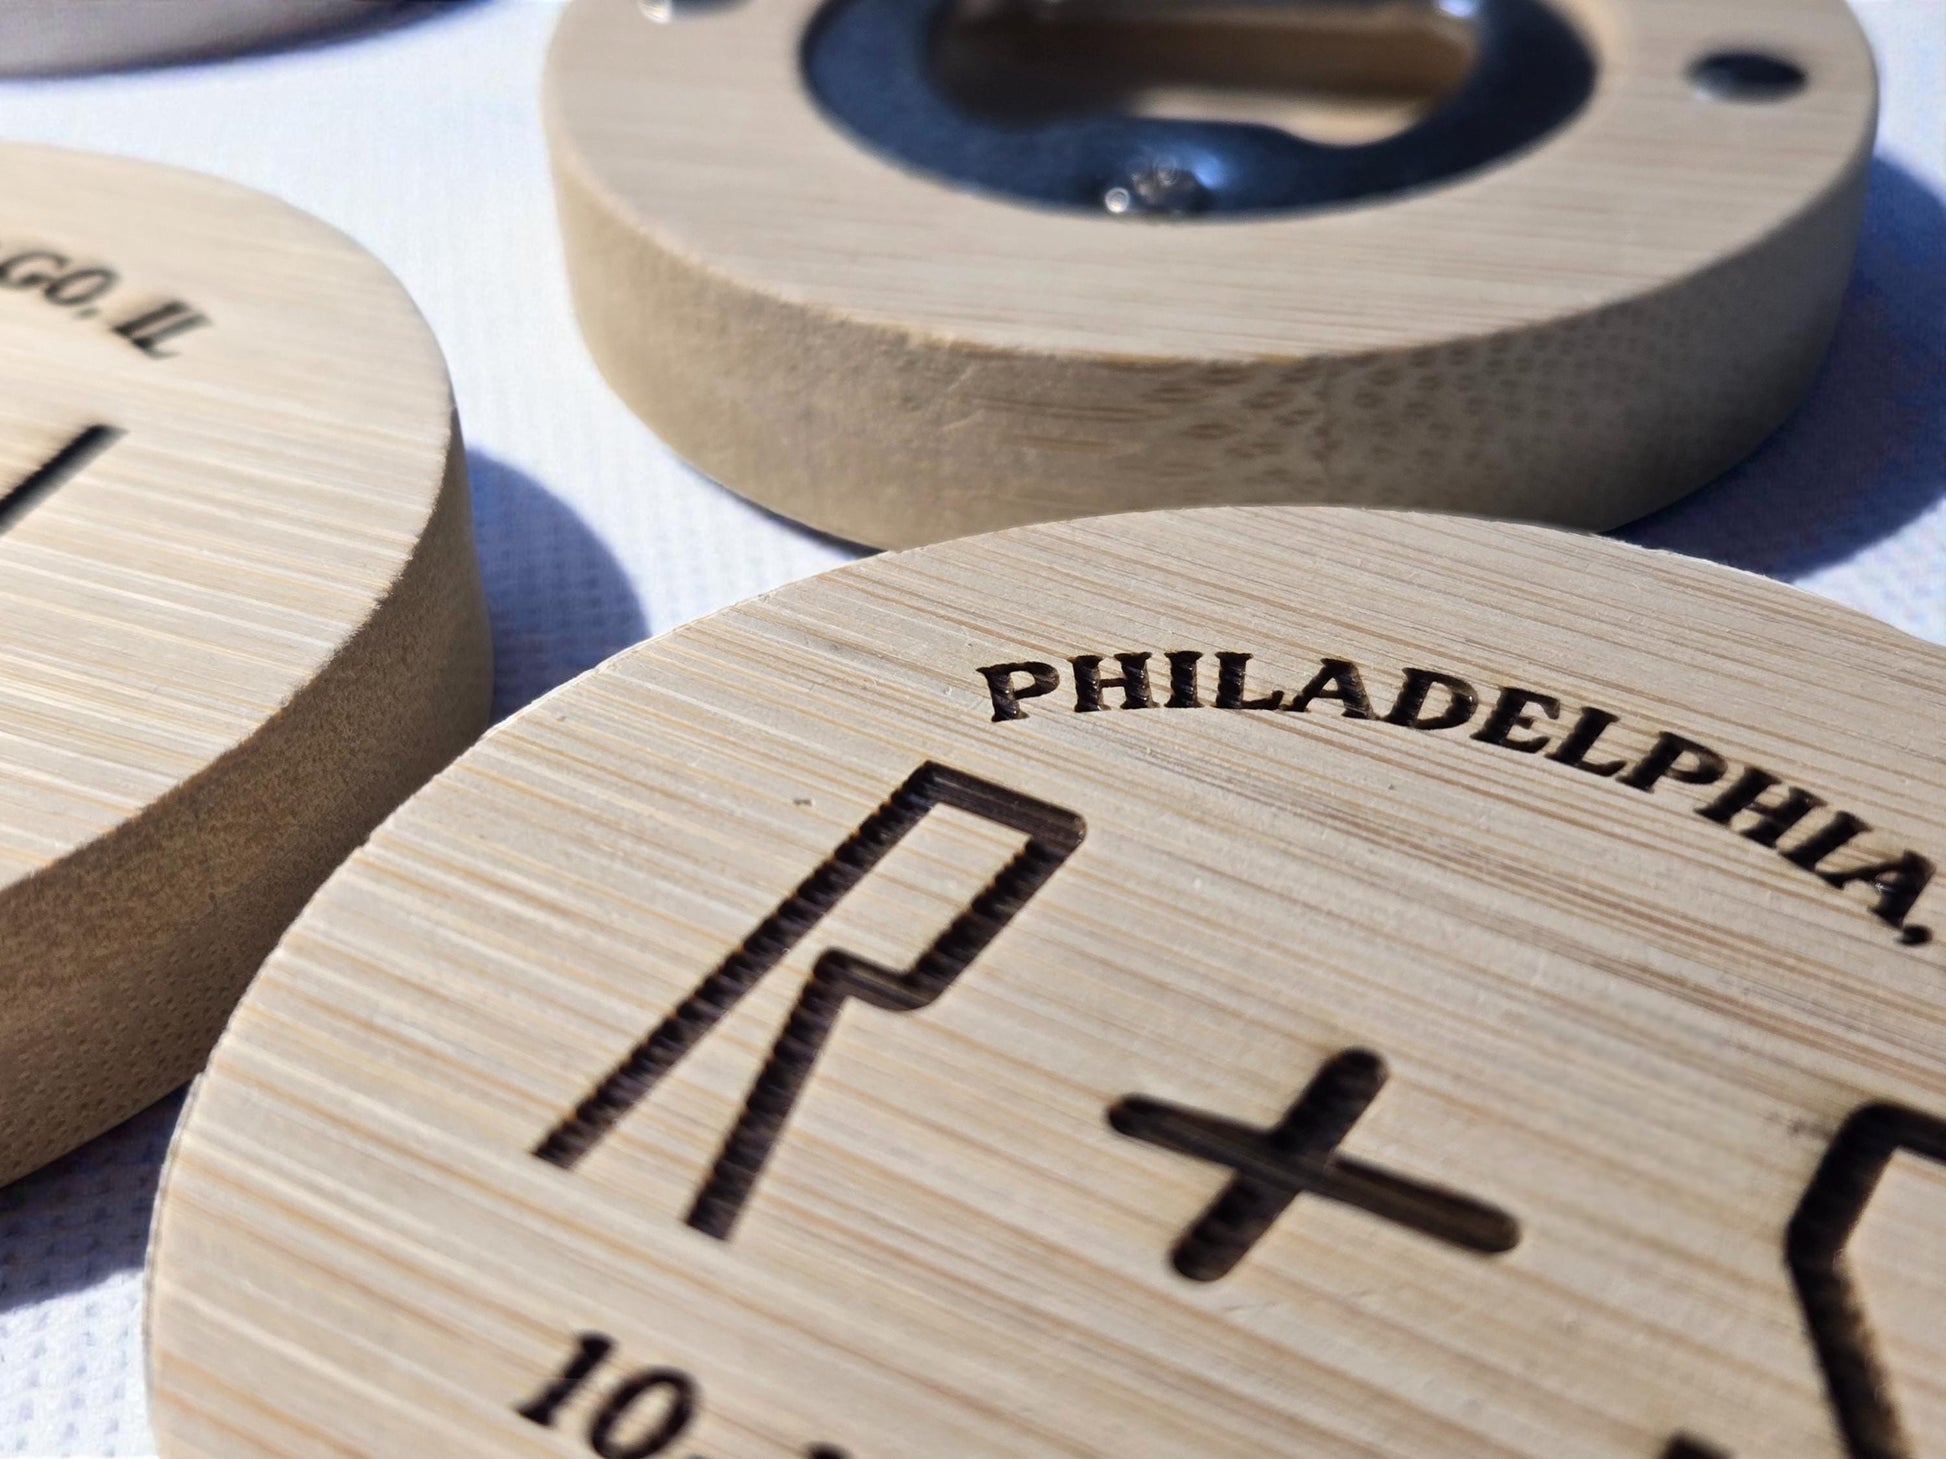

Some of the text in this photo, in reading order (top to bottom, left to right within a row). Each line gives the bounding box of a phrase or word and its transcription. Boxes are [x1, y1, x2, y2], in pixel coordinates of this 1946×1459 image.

[109, 299, 212, 359] IL
[977, 650, 1936, 946] PHILADELPHIA,
[532, 760, 1087, 1240] R
[1105, 1046, 1520, 1283] +
